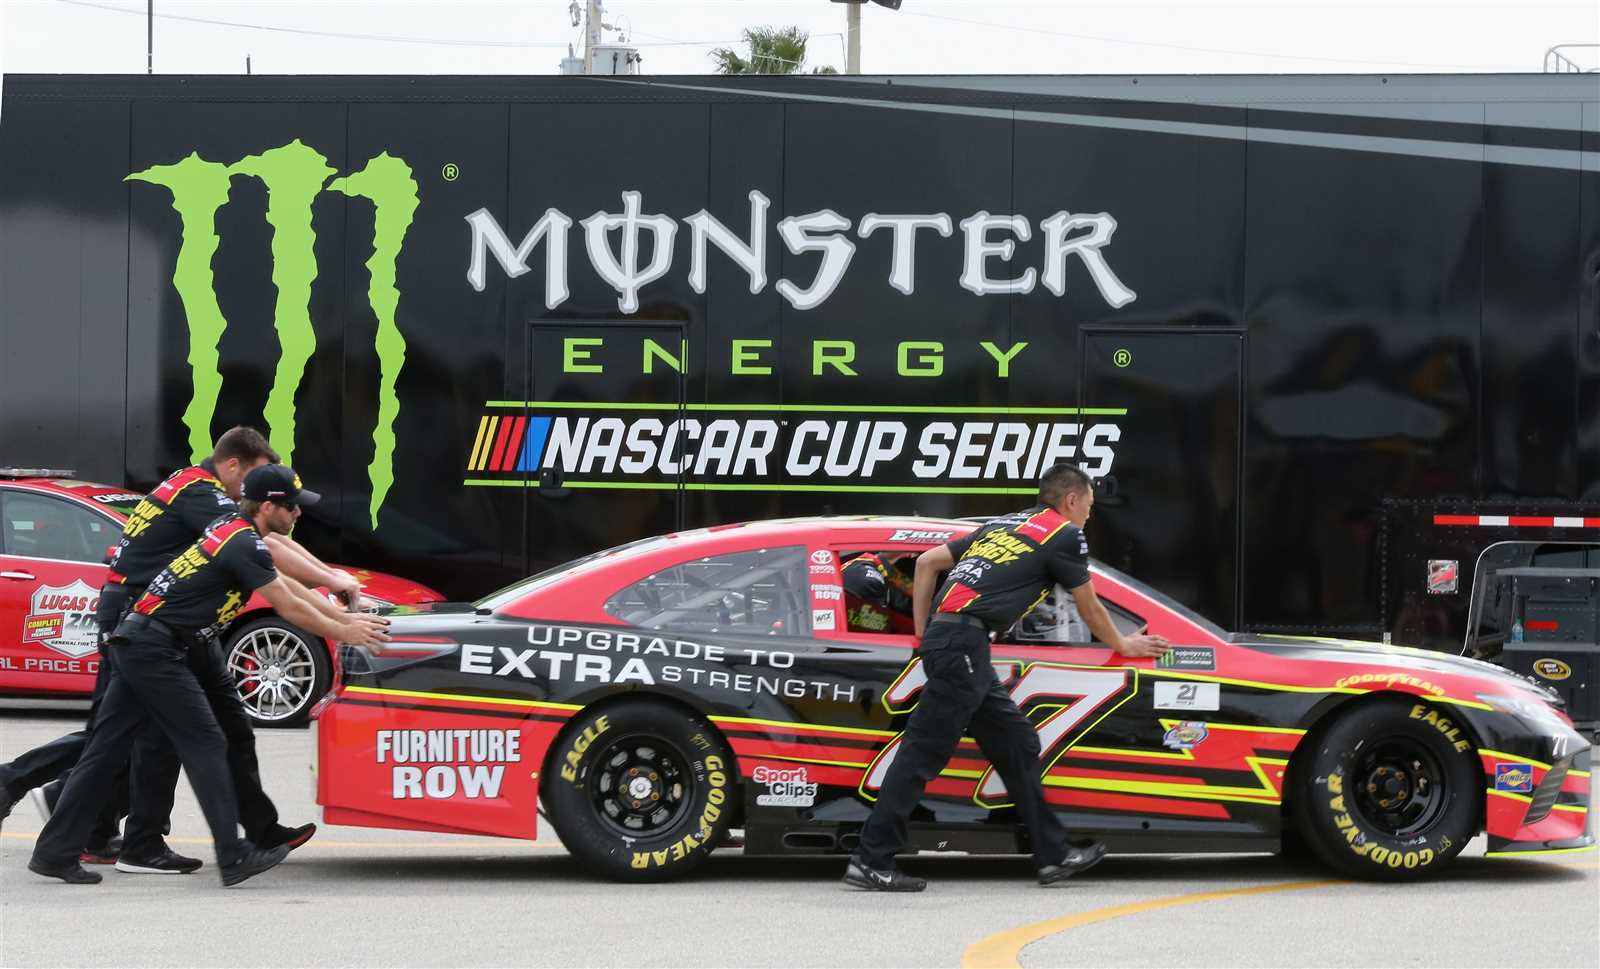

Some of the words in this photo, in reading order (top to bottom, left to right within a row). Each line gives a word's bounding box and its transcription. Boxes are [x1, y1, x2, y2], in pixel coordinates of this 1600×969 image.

[464, 190, 1136, 314] MONSTER
[563, 338, 1028, 378] ENERGY
[542, 416, 779, 475] NASCAR
[785, 418, 906, 478] CUP
[912, 422, 1121, 479] SERIES
[39, 594, 89, 612] LUCAS
[28, 618, 62, 629] COMPLETE
[25, 658, 81, 673] PACE
[527, 627, 725, 663] UPGRADE
[743, 649, 795, 670] TO
[460, 644, 656, 685] EXTRA
[661, 665, 855, 702] STRENGTH
[1176, 684, 1198, 701] 21
[1335, 672, 1446, 697] GOODYEAR
[376, 729, 521, 763] FURNITURE
[1409, 703, 1471, 753] EAGLE
[561, 714, 611, 783] EAGLE
[392, 765, 505, 799] ROW
[752, 766, 808, 784] Sport
[771, 782, 816, 798] Clips
[630, 755, 727, 869] GOODYEAR
[1327, 773, 1434, 869] GOODYEAR
